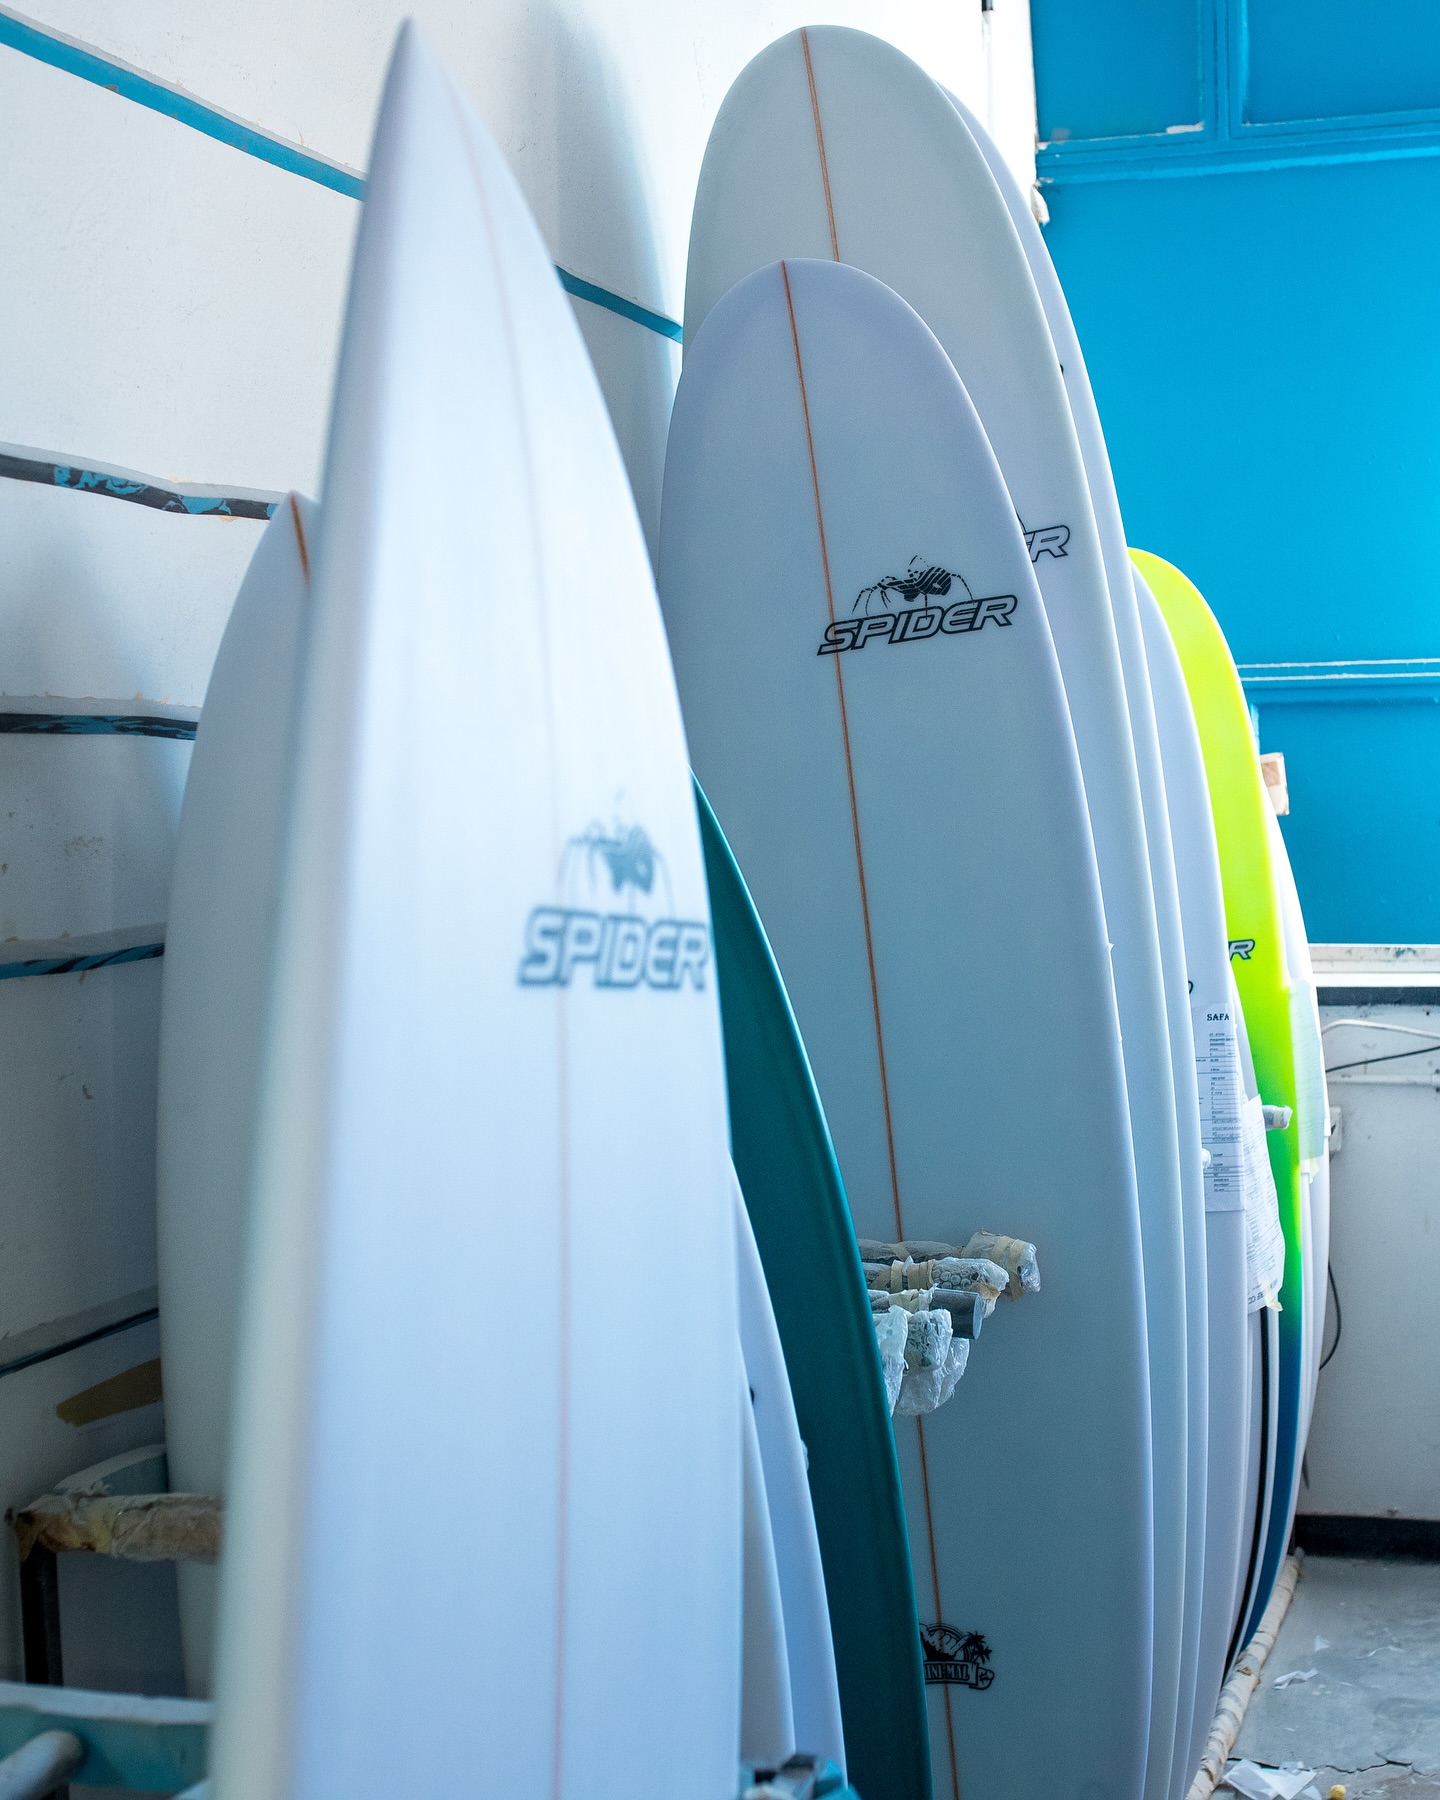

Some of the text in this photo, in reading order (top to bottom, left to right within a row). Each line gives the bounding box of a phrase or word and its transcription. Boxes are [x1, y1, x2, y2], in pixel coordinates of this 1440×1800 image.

[817, 594, 1018, 656] SPIDER
[518, 905, 709, 991] SPIDER
[924, 1664, 969, 1681] INI-MAL
